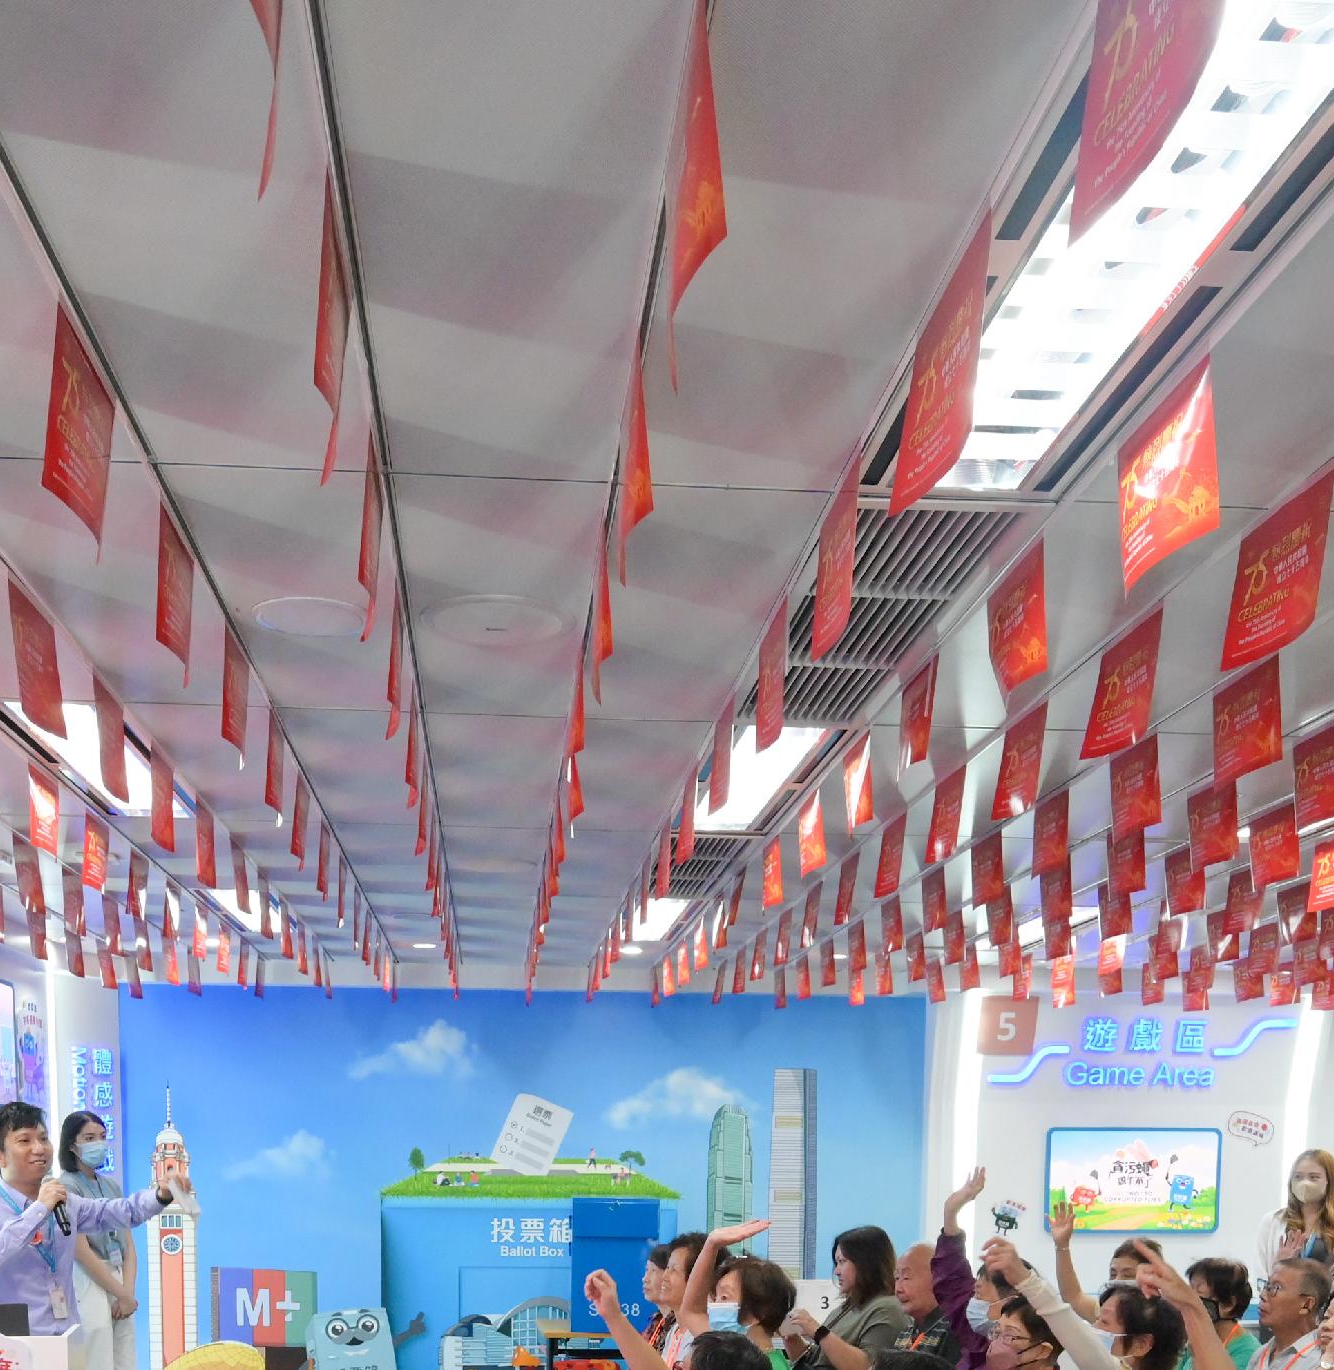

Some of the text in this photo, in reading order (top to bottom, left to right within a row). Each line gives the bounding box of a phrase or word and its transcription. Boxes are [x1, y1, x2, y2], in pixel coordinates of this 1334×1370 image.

[997, 1012, 1016, 1041] 5
[1083, 1018, 1209, 1053] 遊戲區
[72, 1047, 86, 1111] Motion
[1066, 1061, 1215, 1087] Game Area
[491, 1217, 572, 1243] 投票箱
[500, 1245, 564, 1257] Ballot Box
[236, 1287, 300, 1327] M+
[820, 1296, 830, 1310] 3
